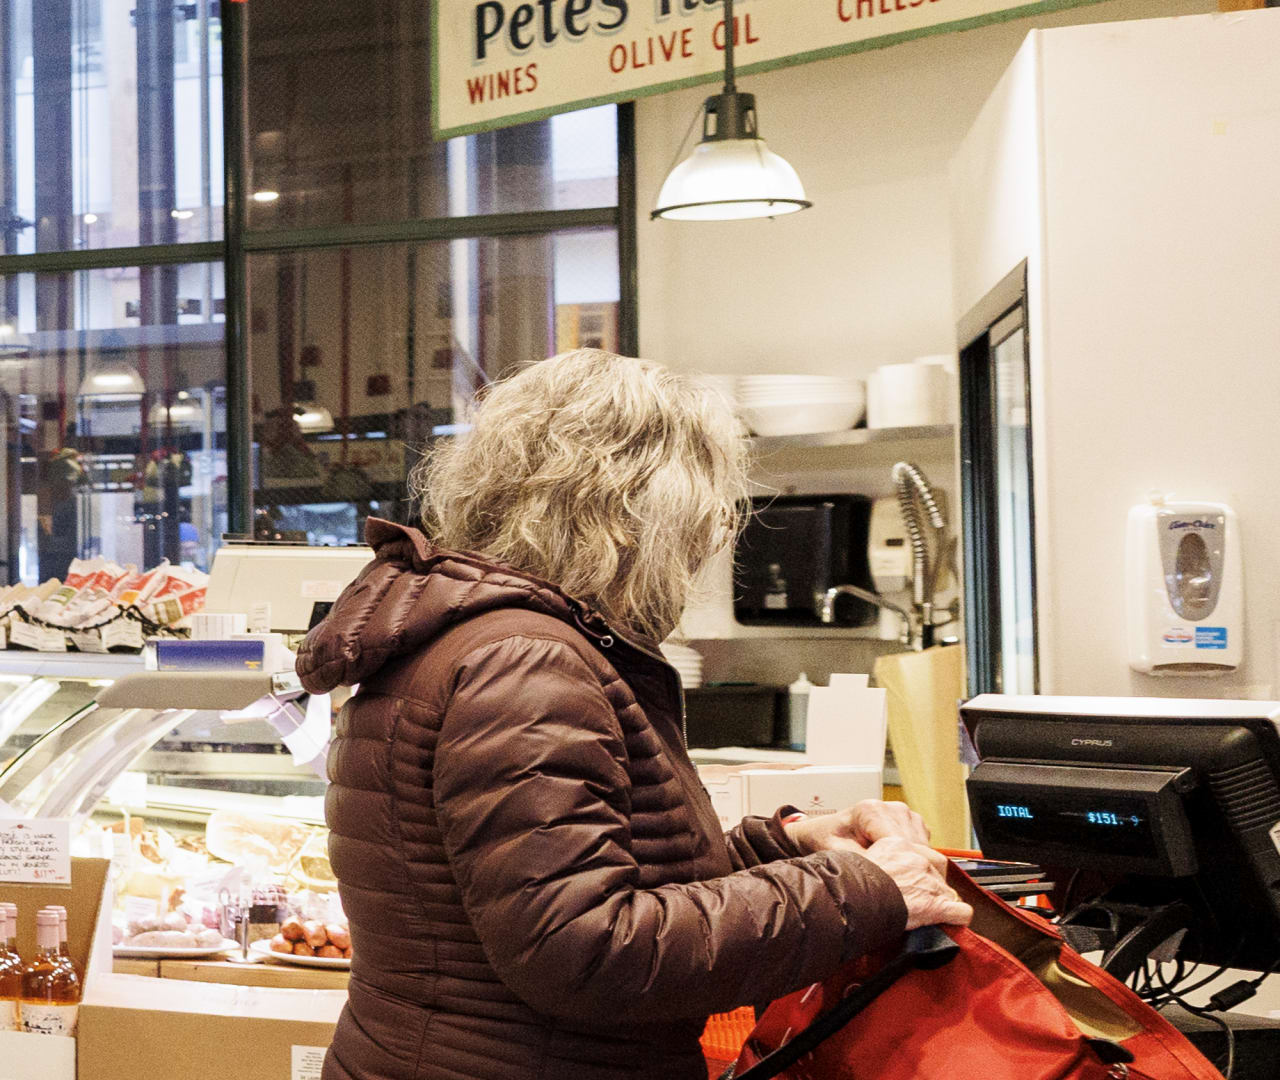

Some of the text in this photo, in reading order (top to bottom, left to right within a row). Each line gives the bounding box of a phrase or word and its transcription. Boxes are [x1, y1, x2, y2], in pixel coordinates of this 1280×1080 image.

[467, 15, 760, 105] WINES OLIVE OIL
